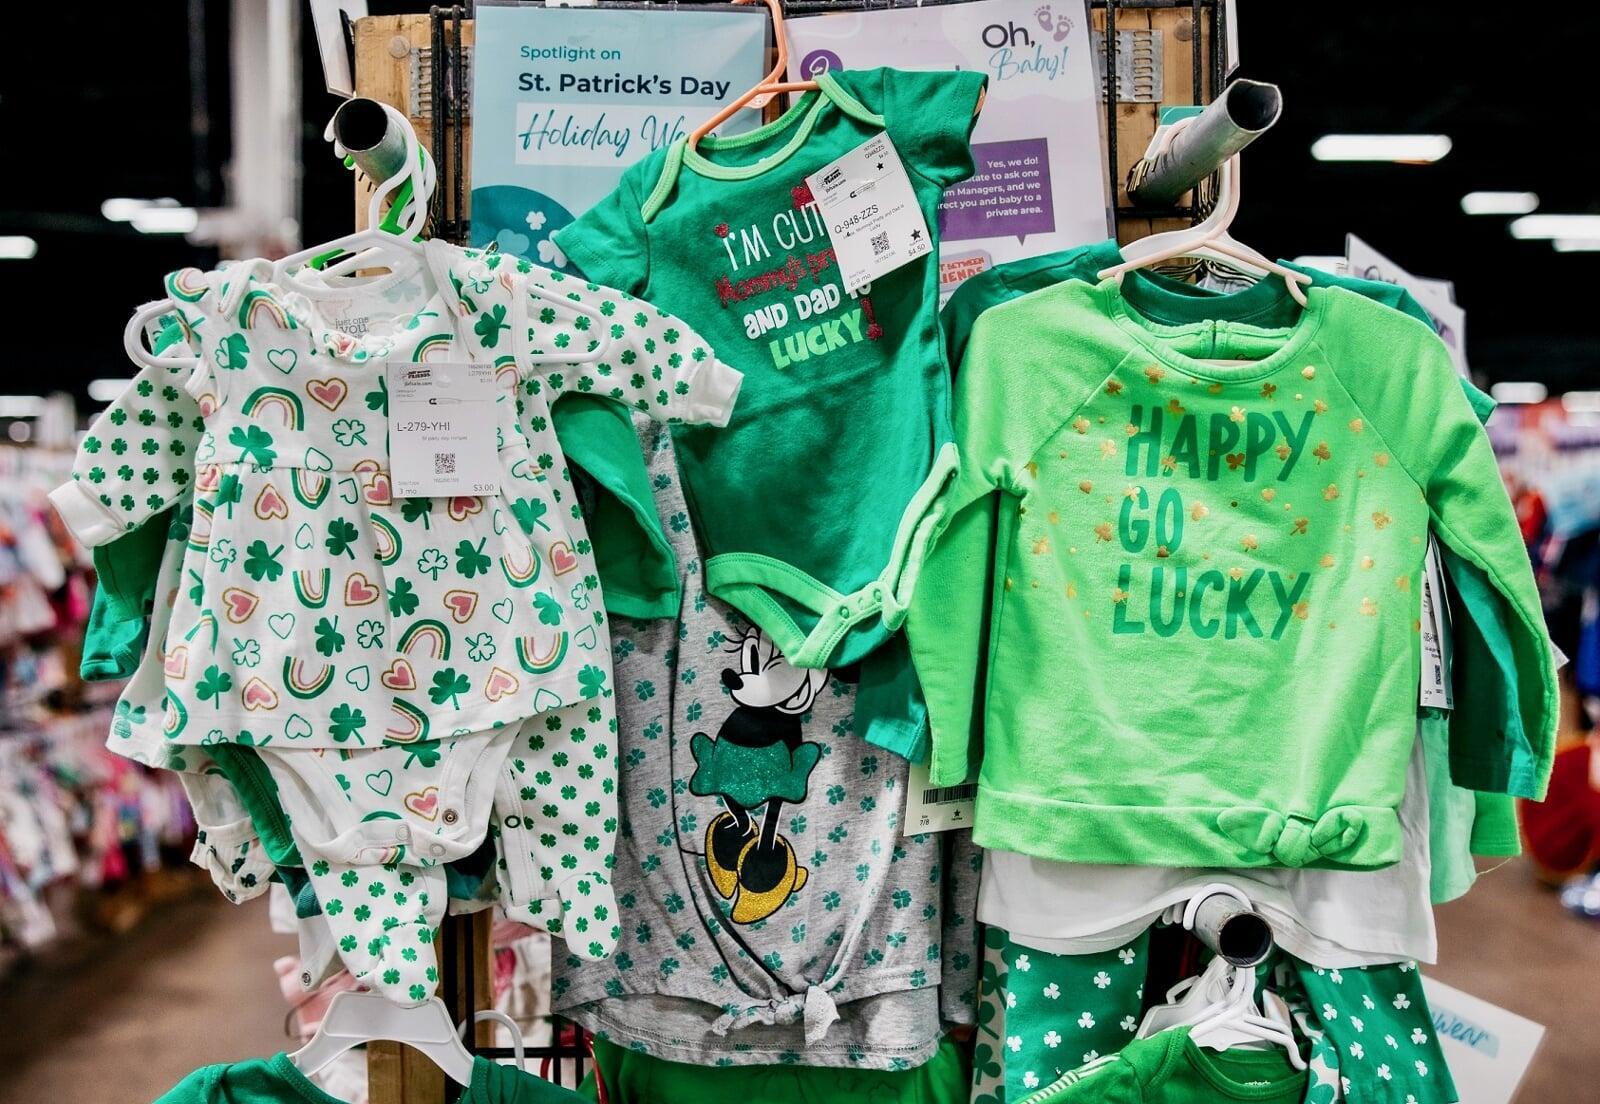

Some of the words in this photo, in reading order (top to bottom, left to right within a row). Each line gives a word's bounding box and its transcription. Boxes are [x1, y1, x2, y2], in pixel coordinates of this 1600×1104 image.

[982, 21, 1036, 48] Oh,
[520, 45, 596, 62] Spotlight
[600, 49, 621, 60] on
[988, 45, 1069, 81] Baby!
[518, 73, 551, 92] St.
[559, 73, 672, 95] Patrick's
[680, 76, 731, 100] Day
[518, 109, 630, 158] Holiday
[987, 160, 1006, 169] Yes,
[1007, 159, 1022, 167] we
[1023, 157, 1039, 165] do!
[1004, 170, 1020, 179] ask
[1021, 170, 1040, 178] one
[957, 185, 1005, 195] Managers,
[1006, 181, 1024, 191] and
[960, 199, 977, 210] you
[980, 196, 997, 206] and
[999, 194, 1022, 205] baby
[1024, 194, 1034, 202] to
[985, 208, 1019, 219] private
[1020, 206, 1043, 214] area.
[772, 200, 825, 250] CUT
[834, 204, 879, 235] Q-948-ZZS
[396, 421, 450, 432] L-279-YHI
[1125, 405, 1316, 482] HAPPY
[1118, 486, 1184, 554] GO
[1112, 564, 1311, 641] LUCKY
